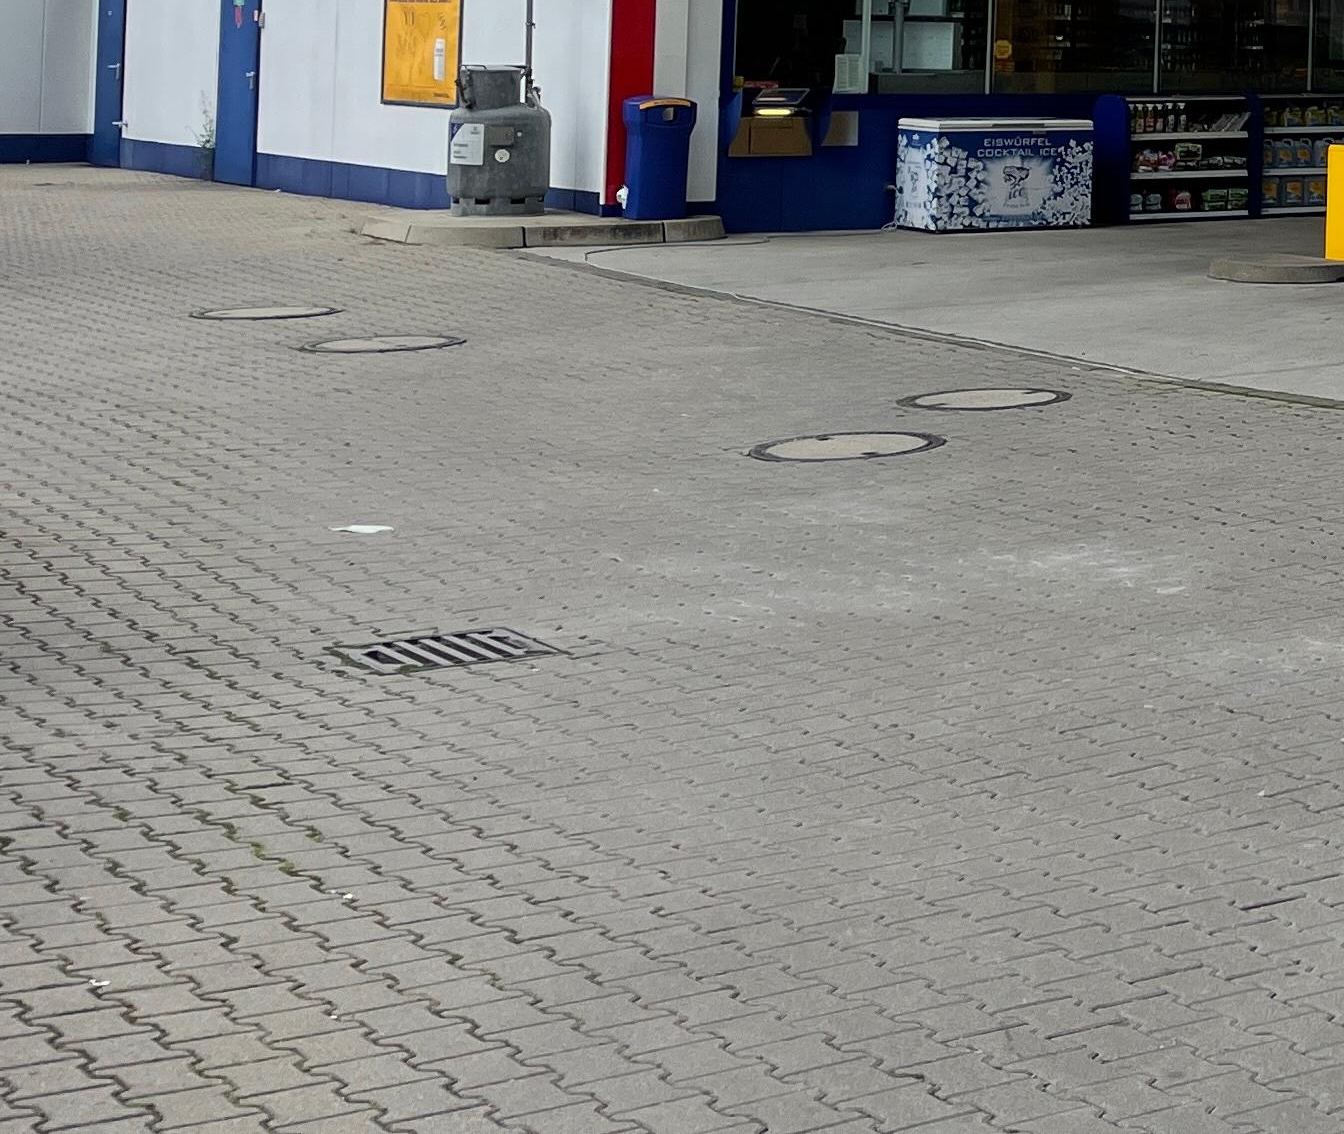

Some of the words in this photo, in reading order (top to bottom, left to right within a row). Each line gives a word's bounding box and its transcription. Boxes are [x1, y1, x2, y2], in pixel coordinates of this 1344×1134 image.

[983, 136, 1053, 148] EISWÜRFEL
[977, 148, 1034, 158] COCKTAIL
[1039, 147, 1058, 157] ICE
